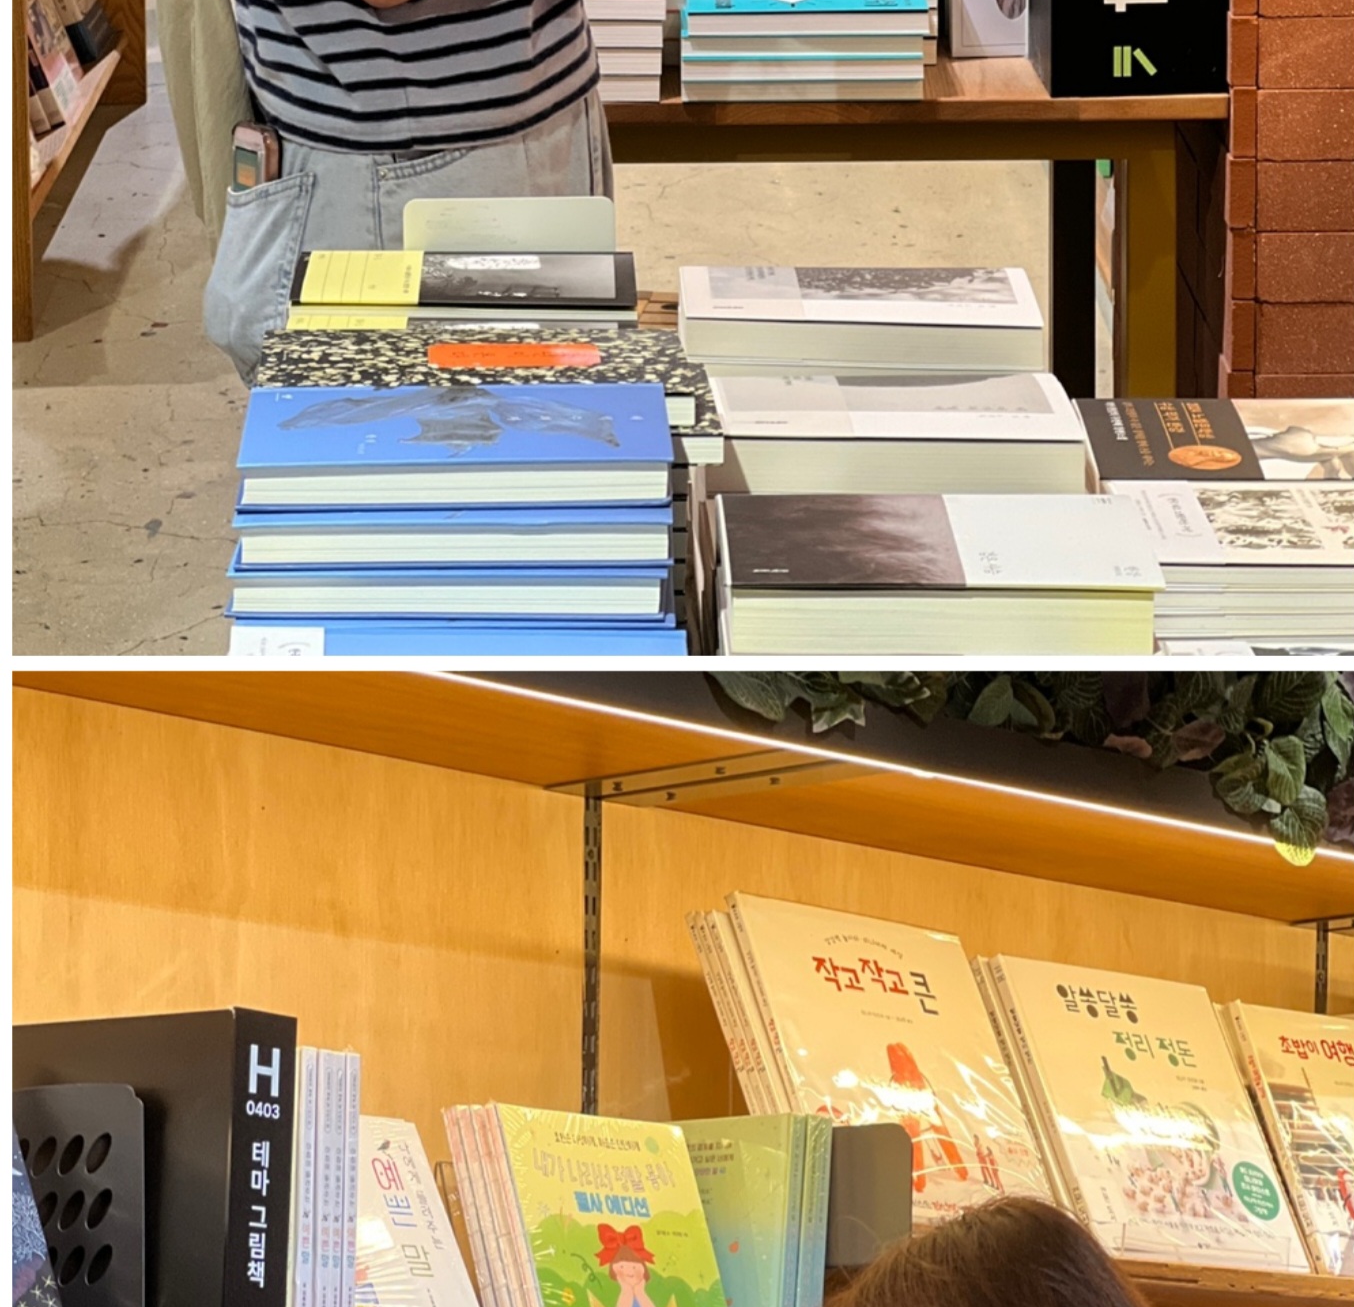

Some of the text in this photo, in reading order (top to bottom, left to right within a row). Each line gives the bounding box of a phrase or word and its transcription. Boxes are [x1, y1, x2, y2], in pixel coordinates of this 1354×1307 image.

[909, 971, 939, 1015] 큰
[1056, 983, 1138, 1024] 알쏭달쏭
[1112, 1030, 1197, 1068] 정리 정돈
[1278, 1035, 1319, 1060] 초밥이
[248, 1043, 281, 1097] H
[245, 1100, 280, 1119] 0403
[247, 1140, 270, 1289] 테마 그림책
